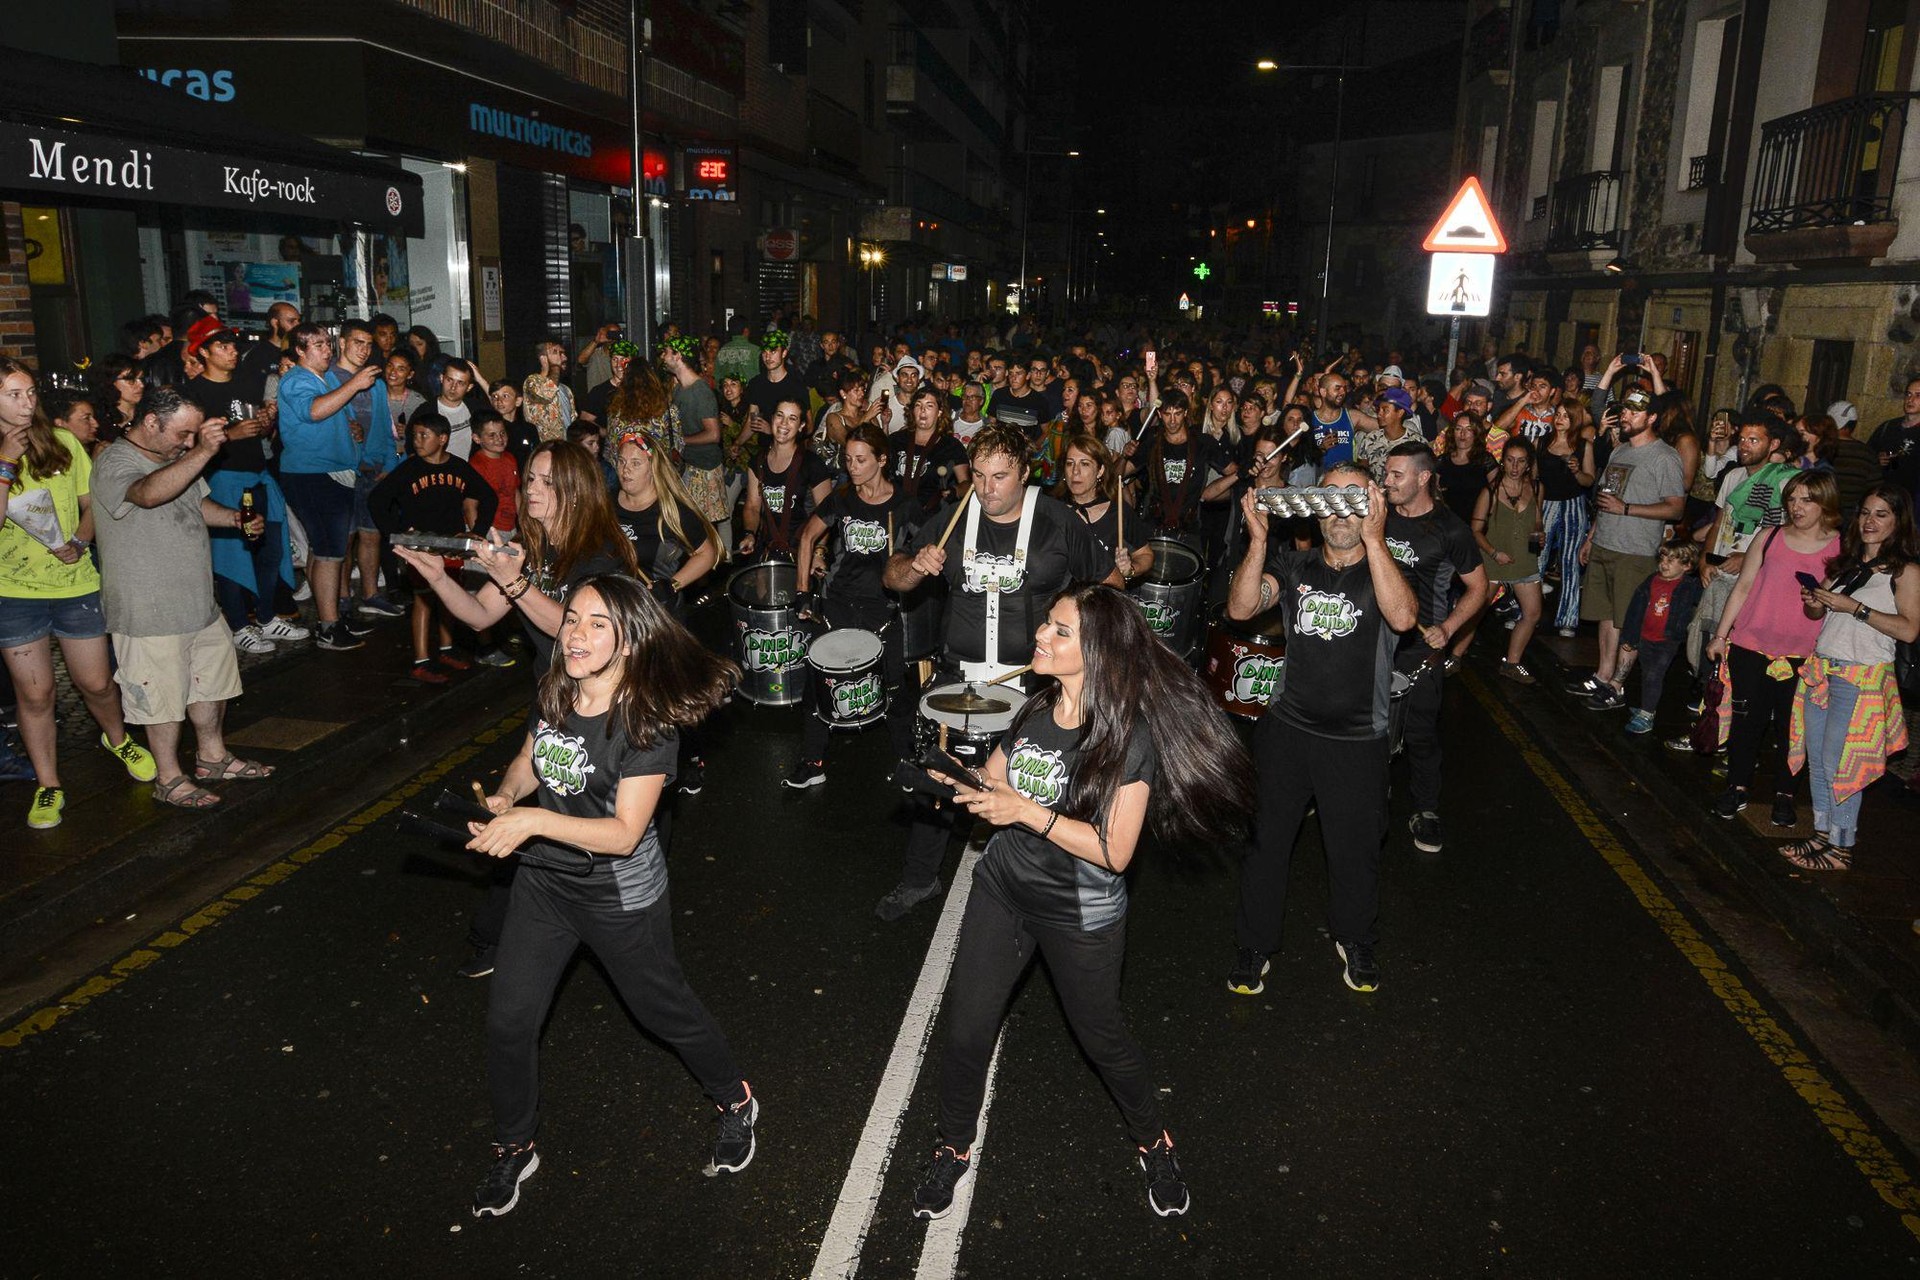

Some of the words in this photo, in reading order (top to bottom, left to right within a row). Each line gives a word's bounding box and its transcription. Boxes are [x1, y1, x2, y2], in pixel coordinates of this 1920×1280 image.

[29, 138, 154, 190] Mendi
[223, 166, 316, 203] Kafe-rock
[749, 632, 794, 653] DINBI
[759, 646, 805, 665] BANDA
[839, 678, 873, 701] DINBI
[536, 740, 579, 769] DINBI
[1012, 754, 1056, 780] DINBI
[542, 761, 582, 790] BANDA
[1017, 773, 1056, 800] BANDA
